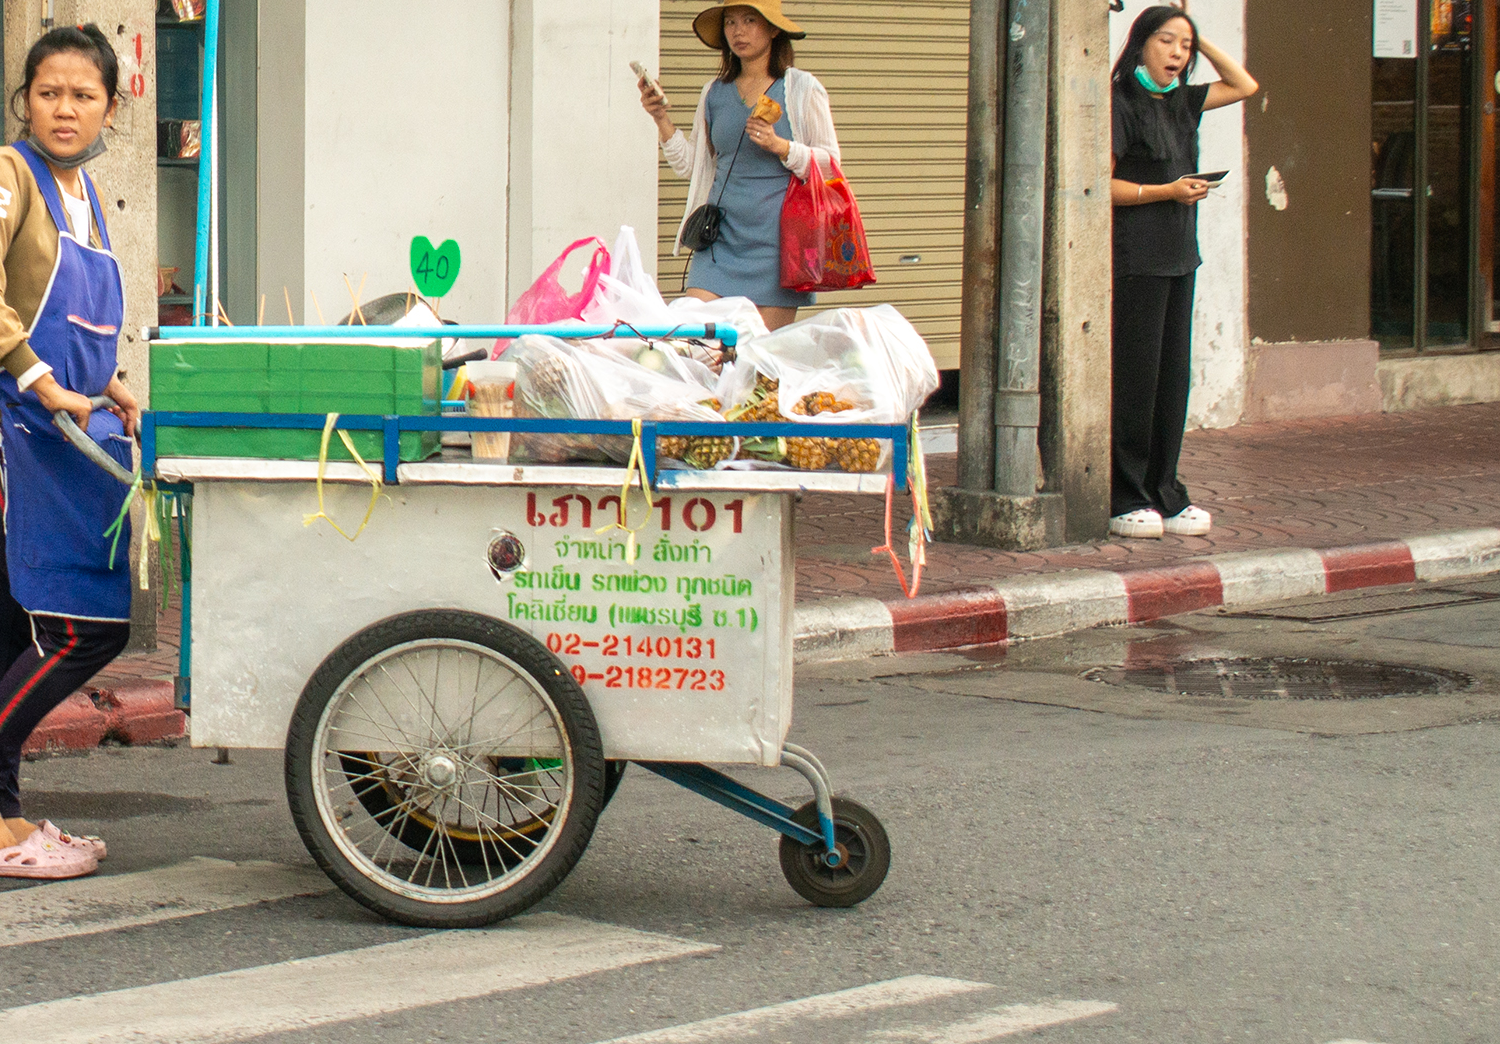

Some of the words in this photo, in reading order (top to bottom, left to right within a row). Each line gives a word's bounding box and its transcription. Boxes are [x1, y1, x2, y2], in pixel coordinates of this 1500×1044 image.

[416, 251, 449, 284] 40
[652, 495, 744, 534] 101
[513, 564, 581, 592] รถเข็น
[546, 632, 716, 660] 02-2140131
